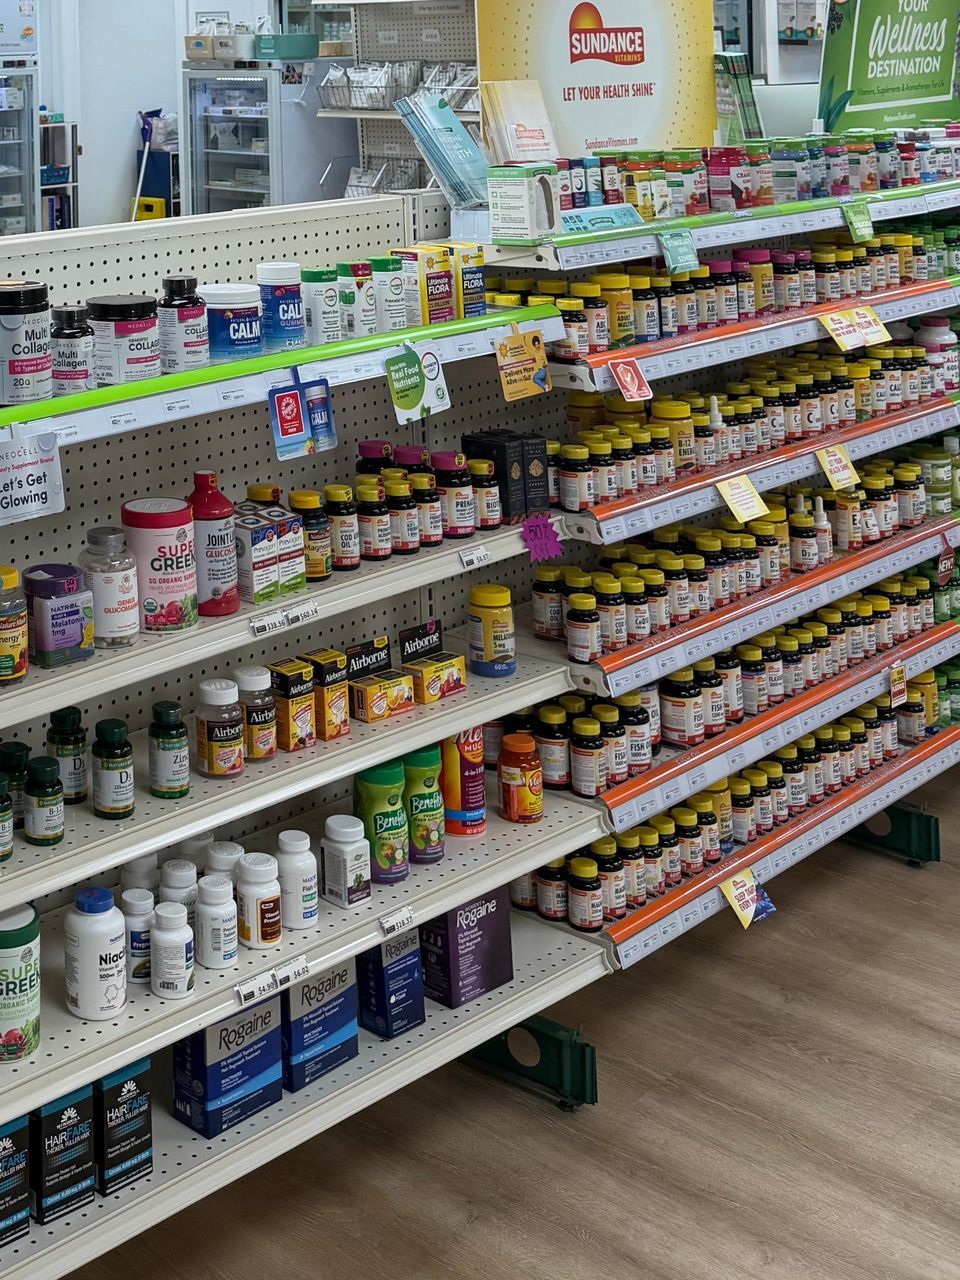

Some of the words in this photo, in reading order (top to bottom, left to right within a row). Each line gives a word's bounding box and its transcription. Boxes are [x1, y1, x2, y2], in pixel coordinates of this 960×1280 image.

[571, 32, 643, 54] SUNDANCE
[868, 15, 947, 59] Wellness
[614, 54, 642, 62] VITAMINS
[868, 56, 941, 79] DESTINATION
[563, 87, 576, 101] LET
[578, 85, 601, 100] YOUR
[603, 83, 630, 99] HEALTH
[585, 136, 638, 150] SundanceVitamins.com
[428, 277, 448, 286] Ultimate
[428, 285, 450, 295] FLORA
[617, 313, 631, 321] ADULT
[25, 327, 48, 342] Multi
[229, 320, 260, 340] CALM
[58, 350, 78, 359] Multi
[52, 358, 87, 369] Collagen
[391, 368, 404, 379] Real
[405, 364, 419, 376] Food
[505, 368, 522, 378] Delivers
[394, 375, 420, 389] Nutrients
[830, 404, 836, 414] C
[845, 399, 849, 408] C
[311, 410, 328, 426] CALM
[771, 418, 777, 428] C
[807, 412, 813, 423] C
[0, 447, 38, 461] NEOCELL
[678, 449, 691, 457] B-12
[11, 459, 39, 471] Supplement
[26, 471, 48, 487] Get
[0, 490, 48, 510] Glowing
[528, 523, 550, 541] 50%
[206, 533, 229, 547] JOINT
[279, 535, 302, 546] Prevagen
[253, 543, 275, 554] Prevagen
[534, 542, 550, 556] OFF
[158, 575, 182, 584] ORGANIC
[51, 616, 86, 629] Melatonin
[267, 620, 285, 631] $38.56
[51, 628, 66, 637] 1mg
[404, 632, 439, 655] Airborne
[349, 648, 388, 672] Airborne
[325, 669, 347, 683] Airborne
[290, 681, 313, 695] Airborne
[651, 709, 659, 719] OIL
[711, 703, 723, 712] FISH
[630, 742, 645, 751] FISH
[614, 751, 627, 760] FISH
[302, 875, 316, 884] MAJOR
[222, 915, 236, 923] MAJOR
[457, 899, 497, 929] Rogaine
[458, 936, 469, 944] Topical
[470, 931, 483, 941] Solution
[463, 926, 478, 937] Minoxidil
[385, 934, 417, 959] Rogaine
[466, 937, 481, 948] Regrowth
[459, 945, 475, 955] Treatment
[294, 966, 309, 979] $6.02
[258, 982, 275, 995] $4.90
[301, 968, 348, 1007] Rogaine
[396, 992, 406, 1000] FOAM
[219, 1009, 272, 1051] Rogaine
[254, 1040, 267, 1051] Solution
[229, 1058, 244, 1070] Regrowth
[244, 1050, 261, 1062] Treatment
[107, 1094, 149, 1122] HAIRFARE
[45, 1123, 90, 1150] HAIRFARE
[66, 1138, 80, 1149] FULLER
[80, 1131, 91, 1142] HAIR
[0, 1168, 15, 1180] FULLER
[15, 1162, 26, 1173] HAIR
